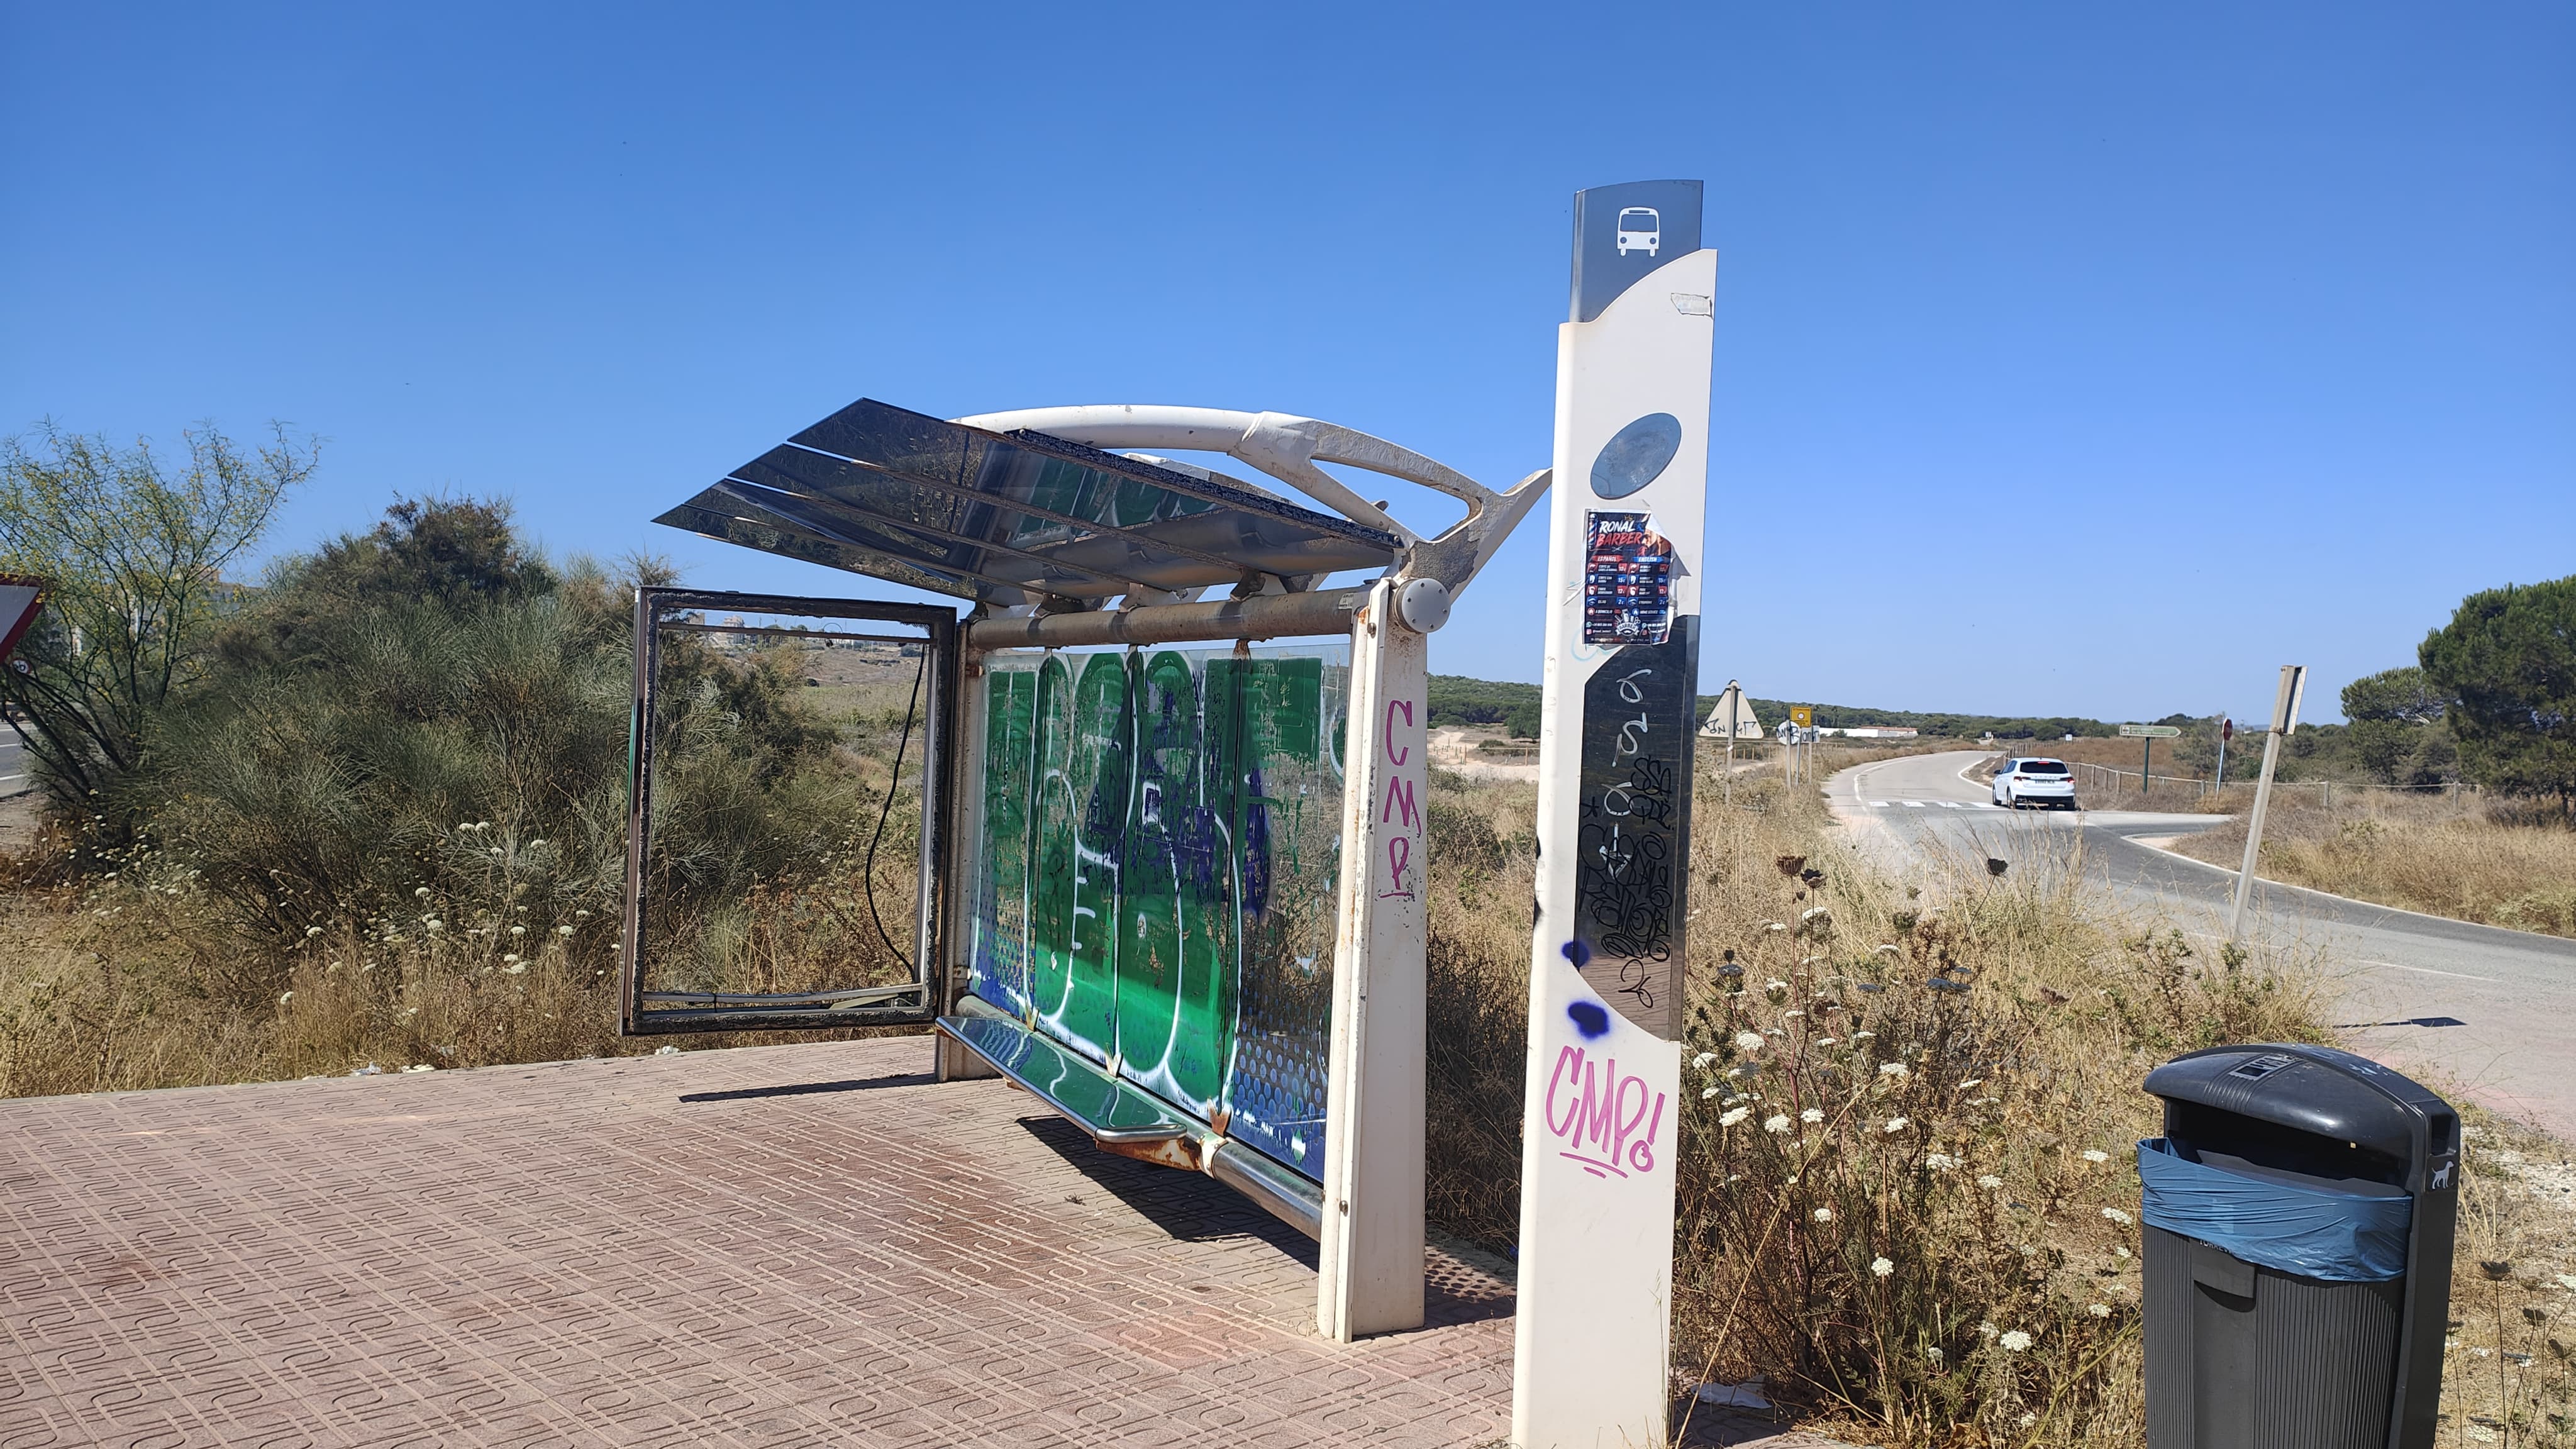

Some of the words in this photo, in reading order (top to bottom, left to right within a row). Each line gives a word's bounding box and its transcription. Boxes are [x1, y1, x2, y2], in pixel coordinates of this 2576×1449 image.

[1599, 520, 1636, 534] RONAL
[1596, 531, 1643, 548] BARBER
[1383, 700, 1422, 891] CMP
